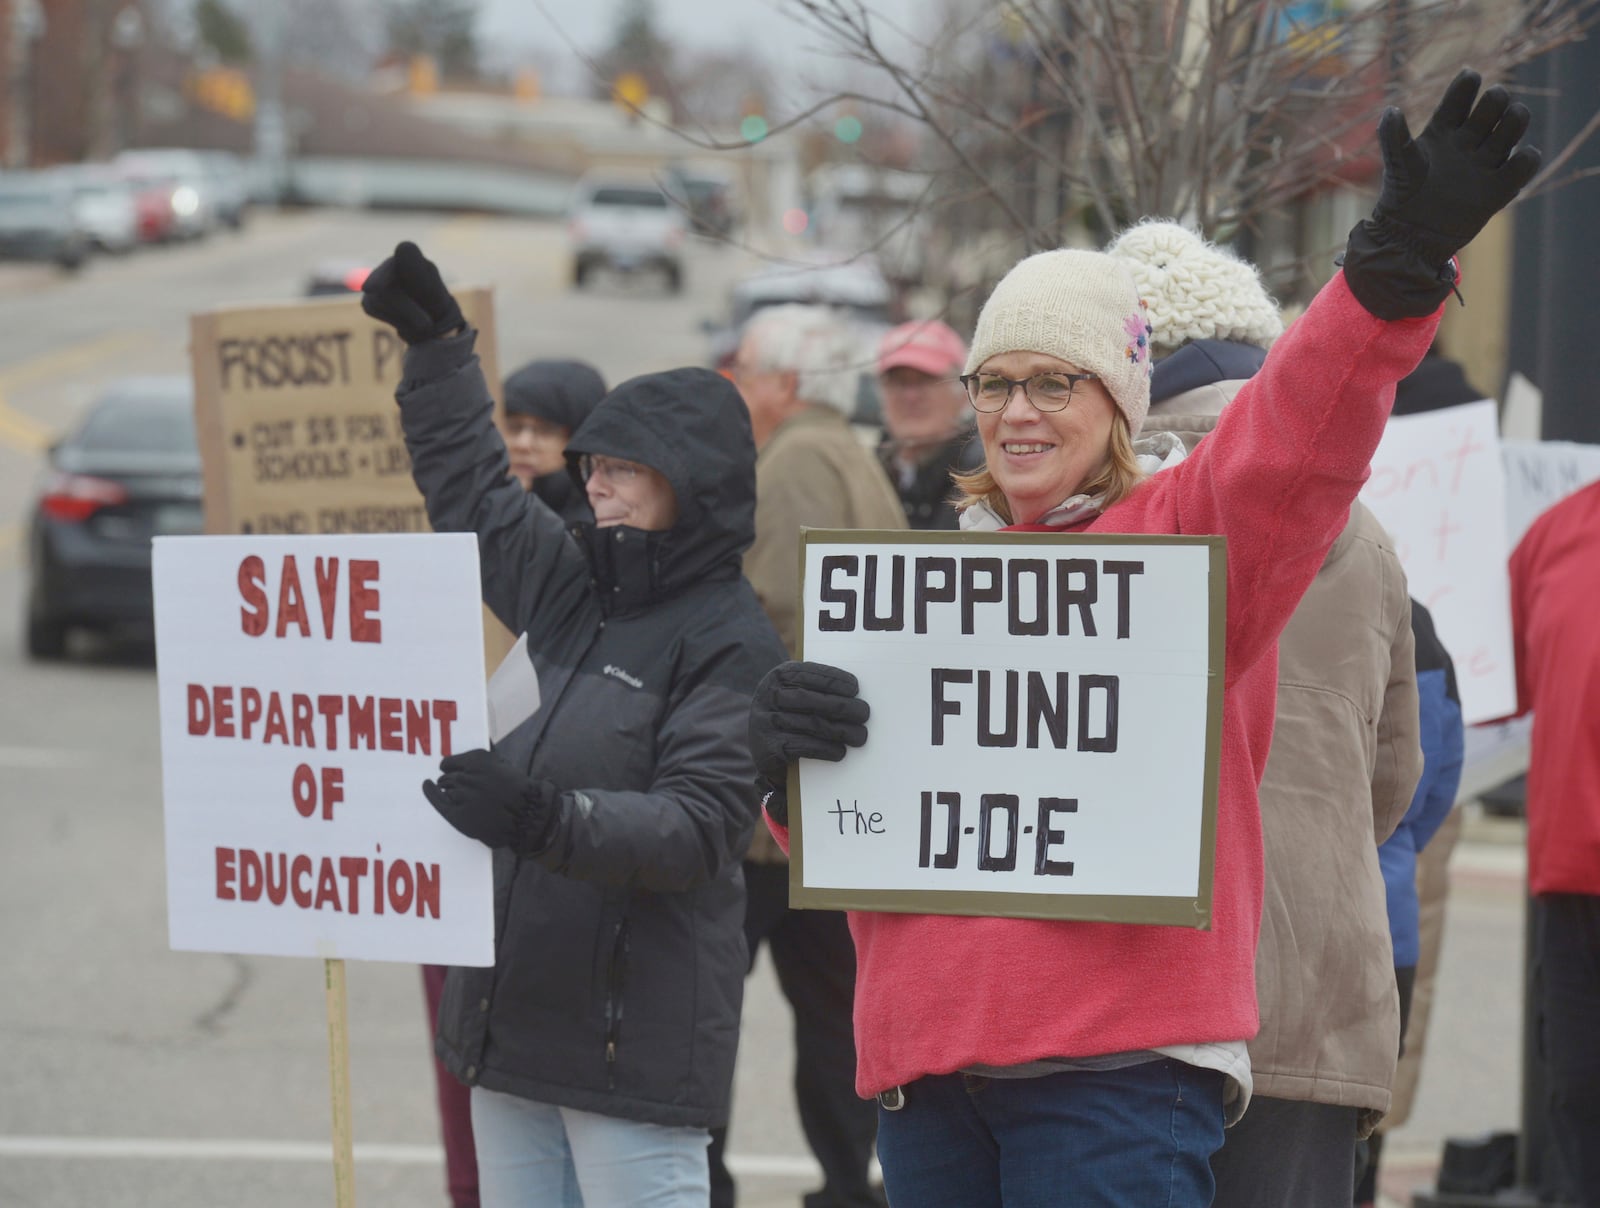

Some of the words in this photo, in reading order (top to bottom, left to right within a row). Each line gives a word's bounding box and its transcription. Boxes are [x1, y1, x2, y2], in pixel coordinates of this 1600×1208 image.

[217, 330, 352, 391] FASCIST
[346, 412, 388, 441] FOR
[255, 448, 352, 483] SCHOOLS
[238, 555, 382, 643] SAVE
[818, 554, 1145, 640] SUPPORT
[187, 684, 458, 757] DEPARTMENT
[930, 667, 1120, 753] FUND
[292, 763, 344, 820] OF
[827, 799, 886, 835] the
